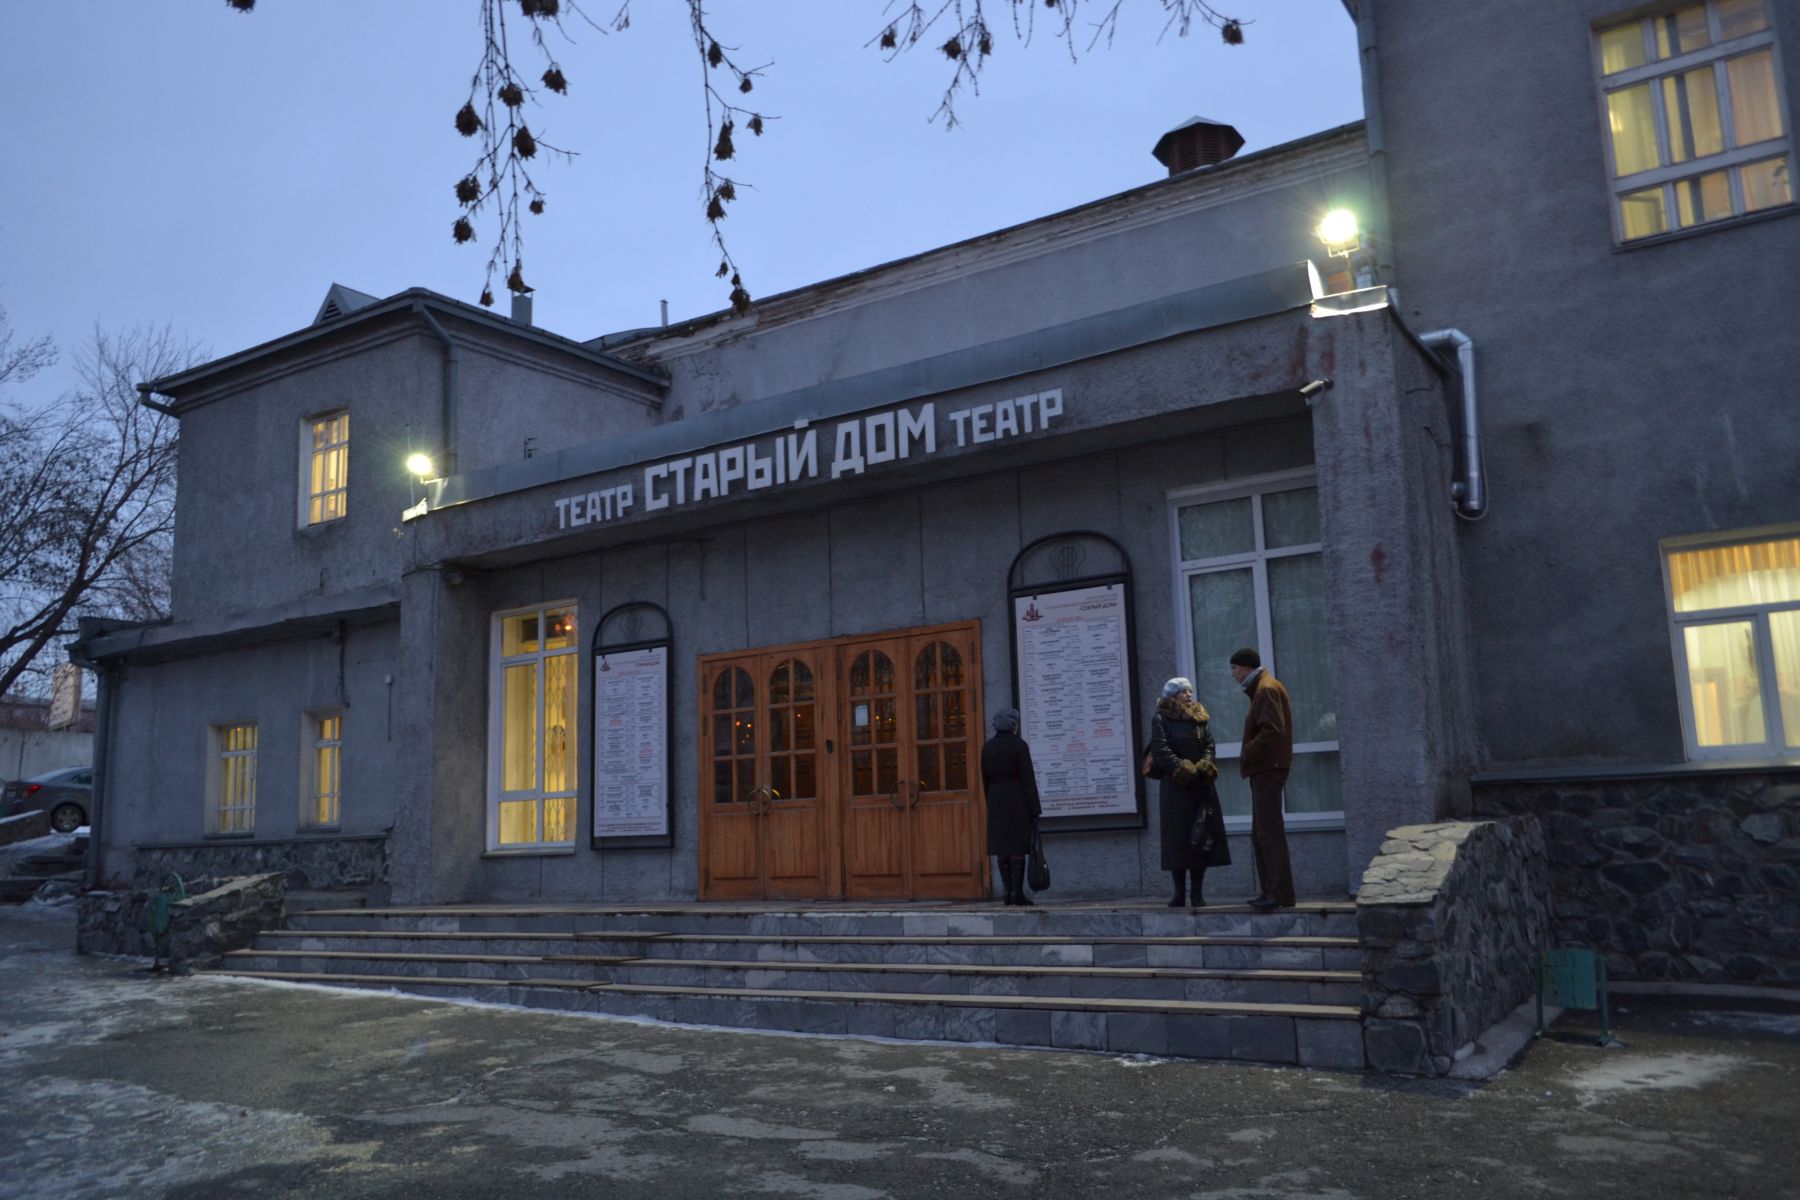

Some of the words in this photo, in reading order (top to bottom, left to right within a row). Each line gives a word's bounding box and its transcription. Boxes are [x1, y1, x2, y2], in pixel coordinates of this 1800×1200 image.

[555, 484, 633, 529] ТЕАТР
[644, 419, 818, 512] СТАРЫЙ
[831, 403, 936, 479] ДОМ
[948, 388, 1064, 447] ТЕАТР
